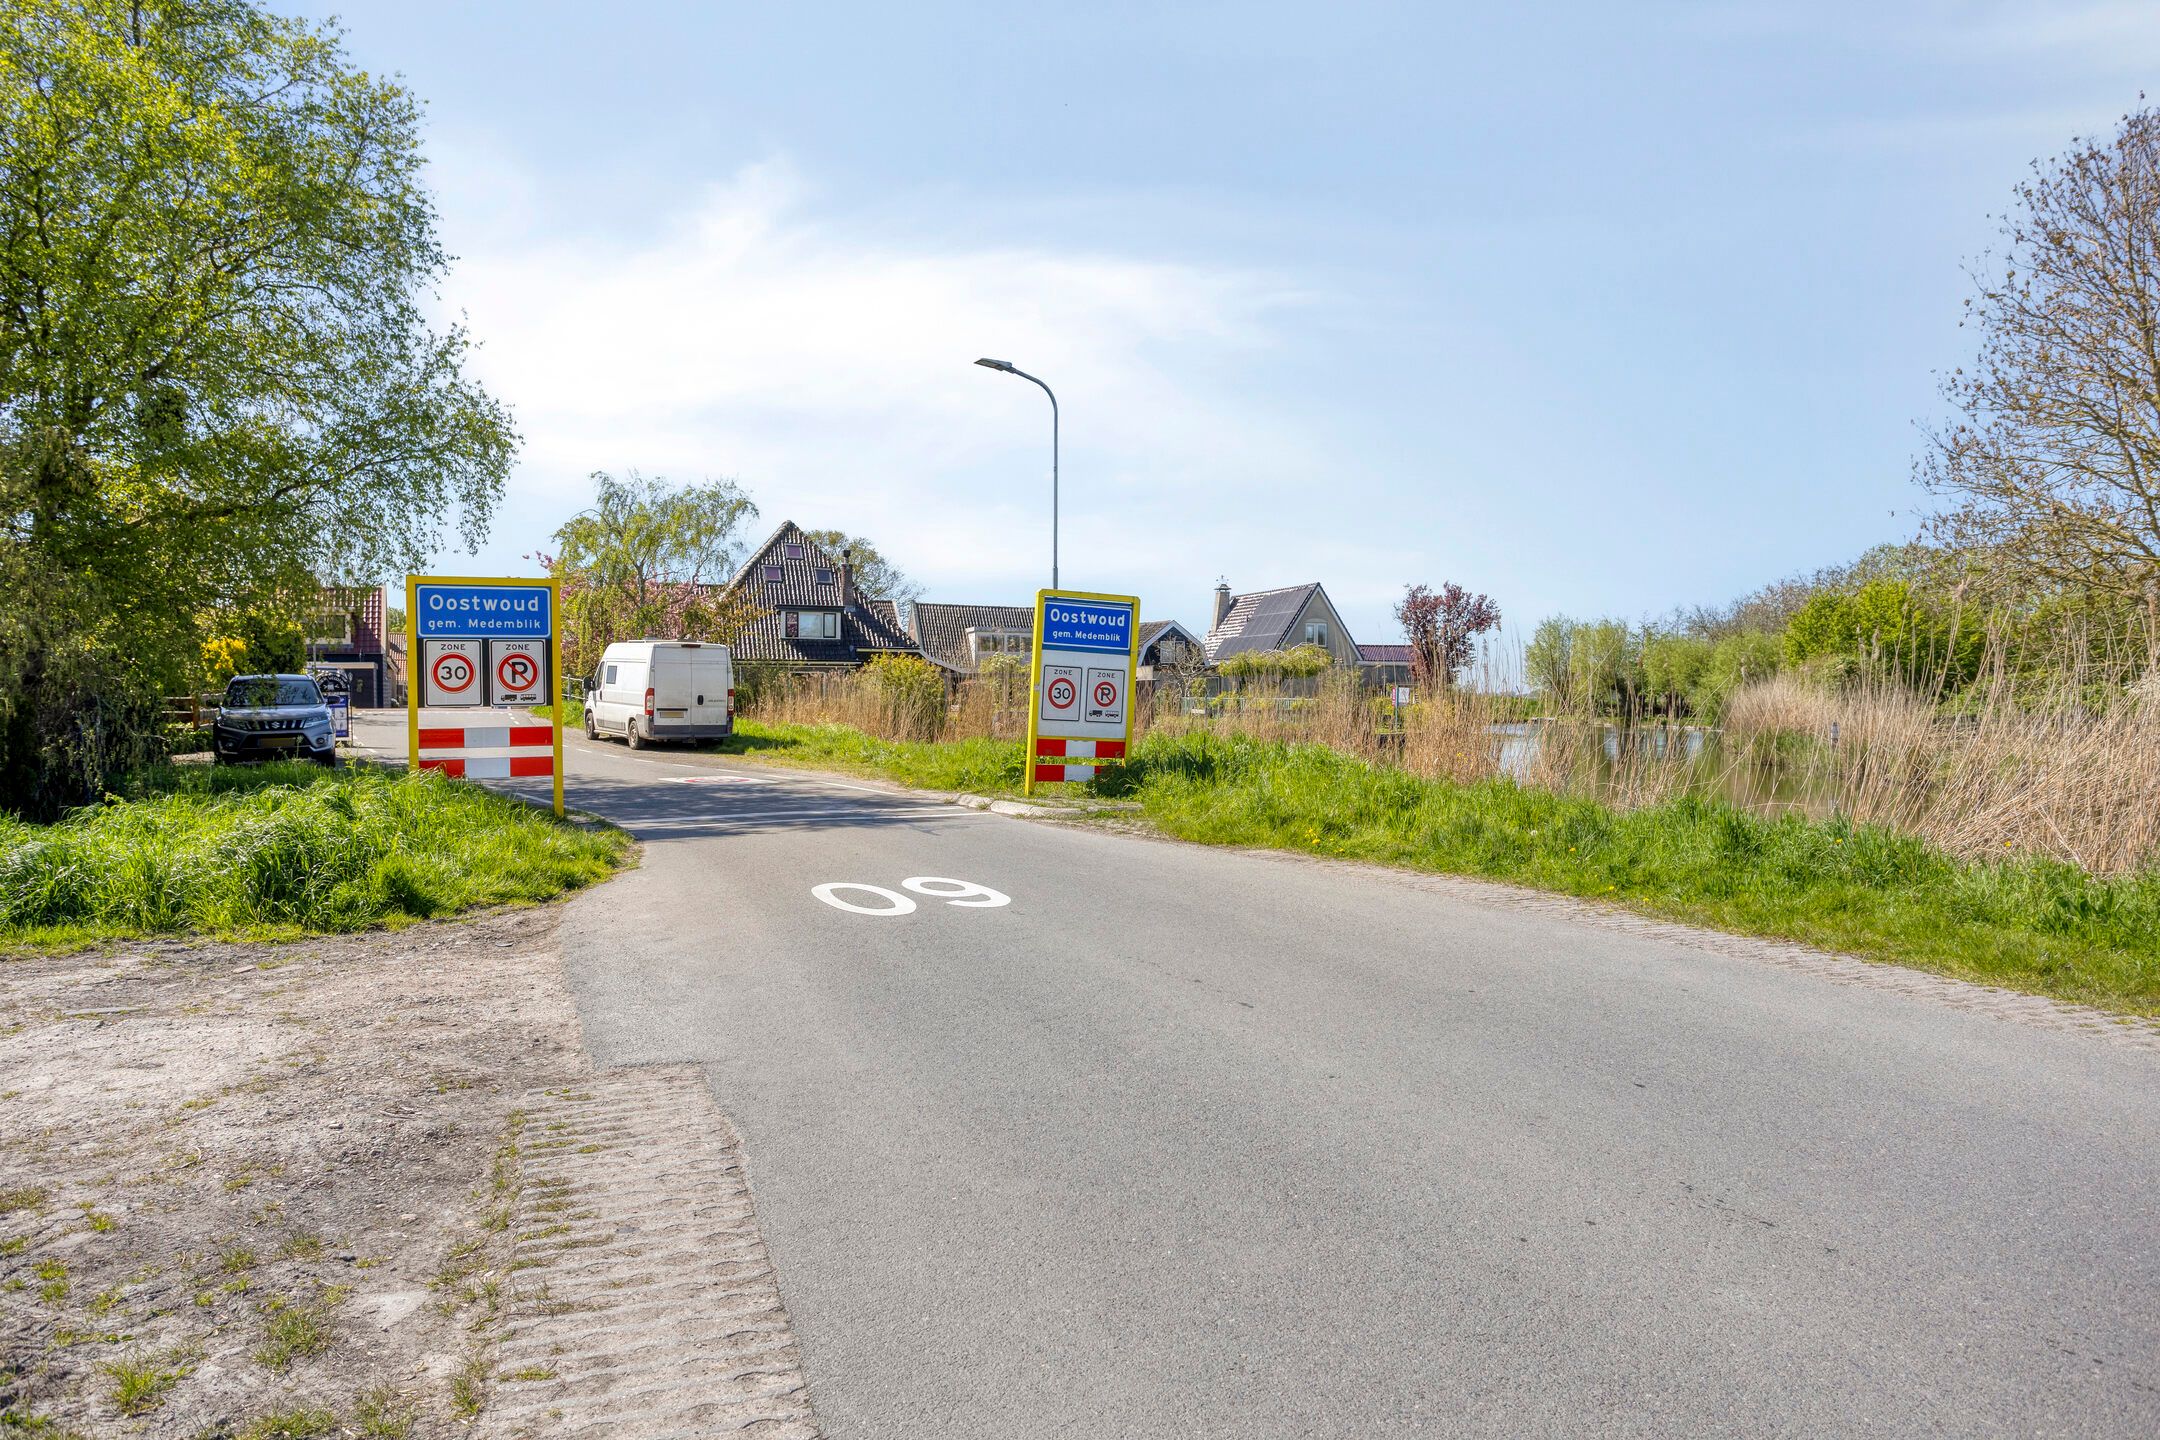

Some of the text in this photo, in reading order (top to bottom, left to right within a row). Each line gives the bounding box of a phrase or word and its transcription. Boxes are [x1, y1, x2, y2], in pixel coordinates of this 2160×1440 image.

[429, 594, 539, 612] Oostwoud
[1050, 608, 1126, 626] Oostwoud
[428, 618, 541, 630] gem. Medemblik
[1052, 630, 1121, 641] gem. Medemblik
[440, 643, 466, 651] ZONE
[505, 643, 530, 651] ZONE
[440, 666, 467, 680] 30
[1053, 687, 1071, 700] 30
